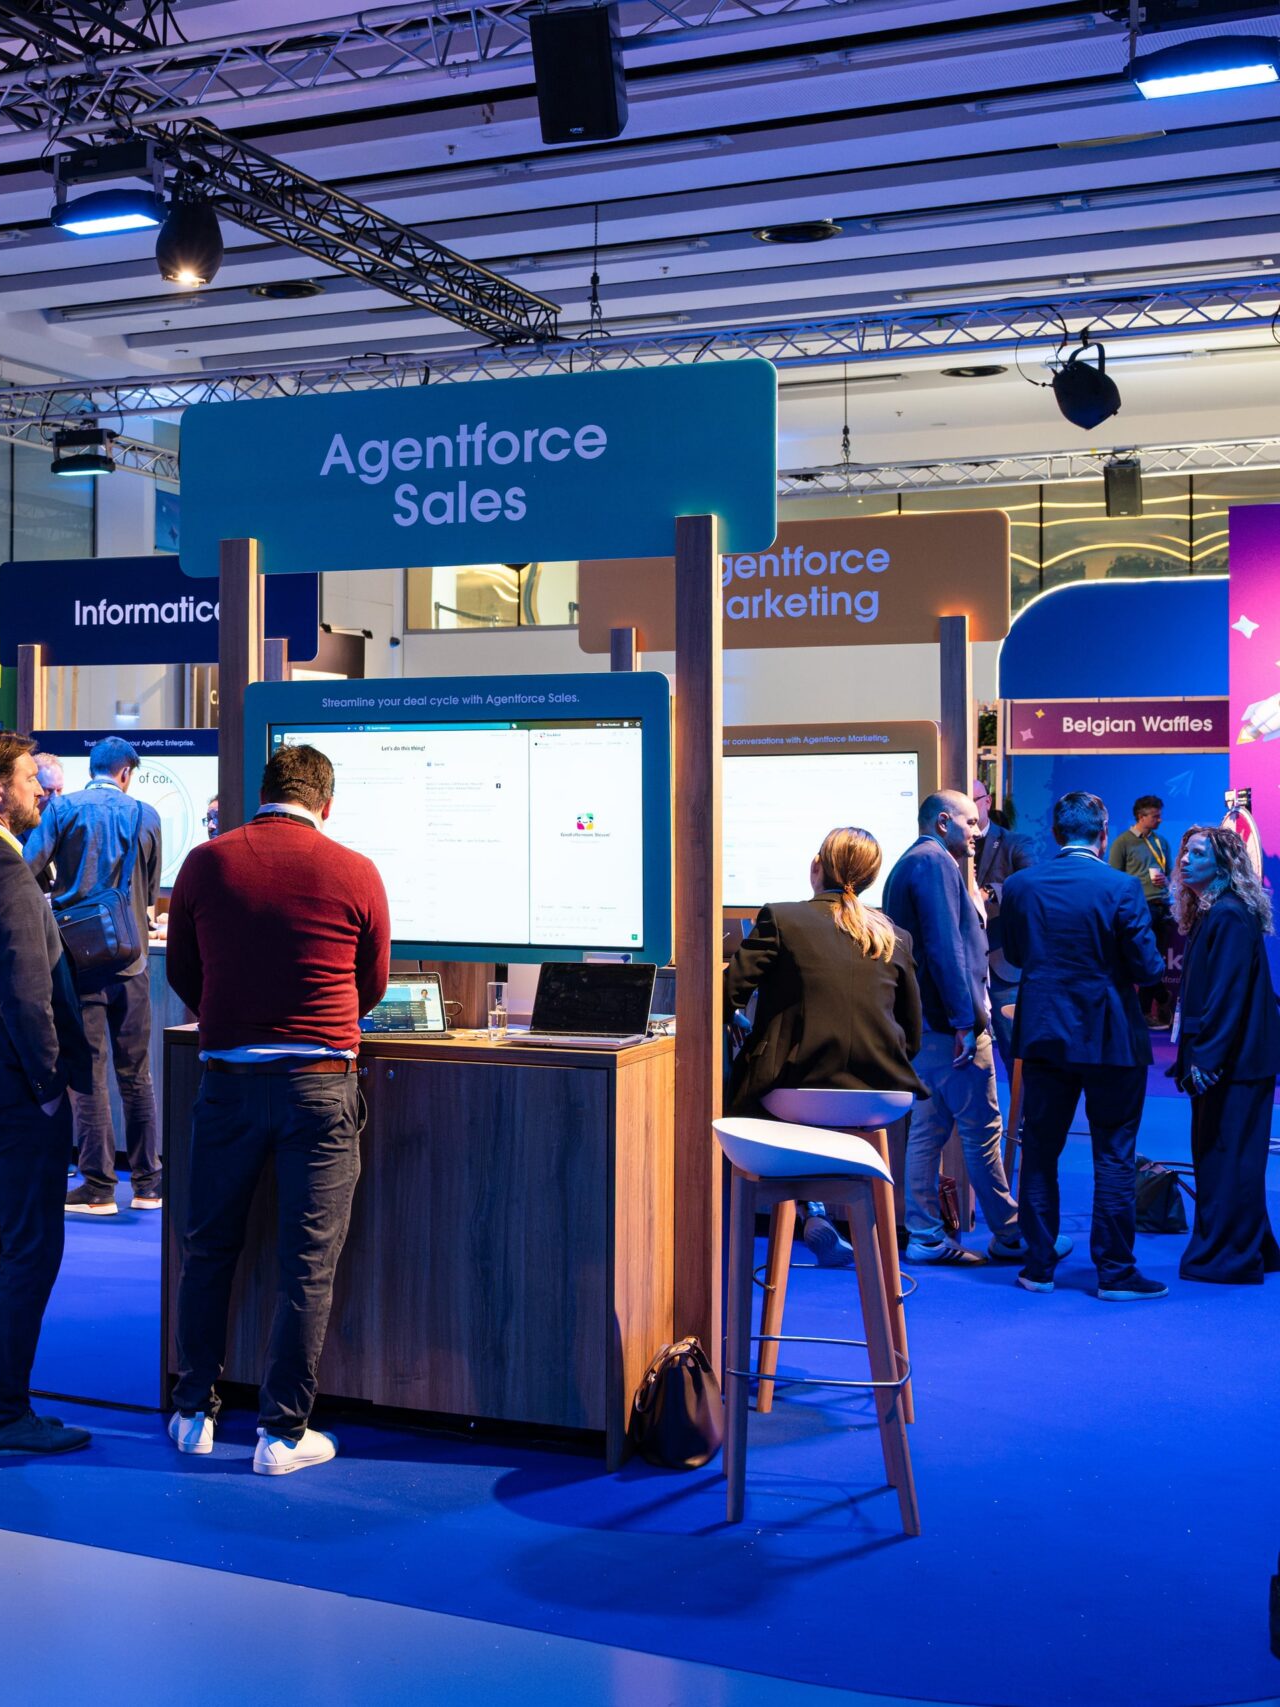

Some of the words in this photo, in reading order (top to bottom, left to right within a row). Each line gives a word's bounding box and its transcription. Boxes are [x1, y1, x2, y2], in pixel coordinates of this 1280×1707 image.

[319, 422, 608, 485] Agentforce
[392, 481, 527, 527] Sales
[722, 545, 890, 587] gentforce
[722, 586, 880, 623] arketing
[322, 697, 375, 708] Streamline
[378, 699, 401, 709] your
[403, 696, 427, 706] deal
[429, 695, 459, 708] cycle
[461, 694, 483, 705] with
[486, 693, 546, 707] Agentforce
[548, 692, 580, 703] Sales.
[1062, 715, 1136, 737] Belgian
[1141, 715, 1213, 733] Waffles
[141, 740, 164, 748] Agentic
[165, 739, 195, 748] Enterprise.
[732, 736, 784, 746] conversations
[785, 735, 801, 744] with
[803, 735, 846, 745] Agentforce
[138, 771, 150, 784] of
